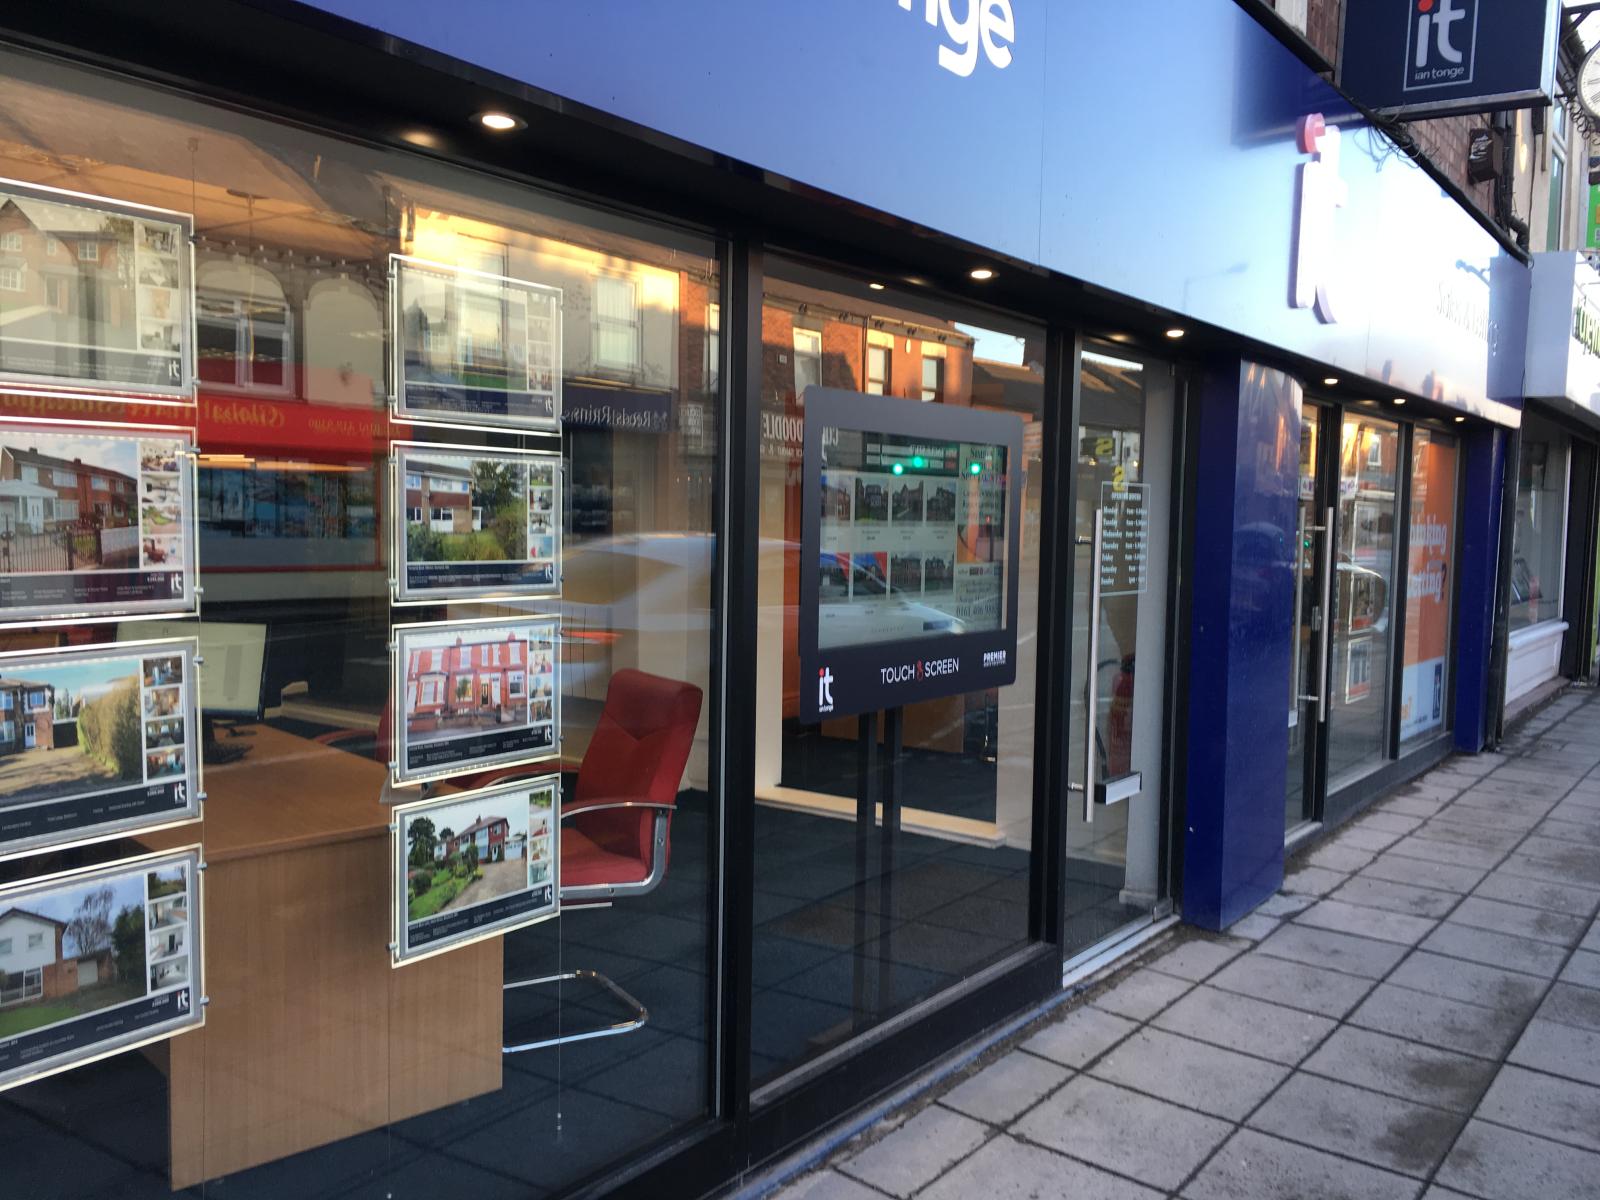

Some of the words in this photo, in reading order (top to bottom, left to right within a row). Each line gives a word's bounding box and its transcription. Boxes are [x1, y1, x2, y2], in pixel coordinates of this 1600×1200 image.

[1415, 0, 1466, 67] it
[1415, 70, 1430, 80] ian
[1432, 66, 1464, 79] tonge
[983, 649, 1006, 663] PREMIER
[880, 664, 915, 684] TOUCH
[925, 657, 959, 678] SCREEN
[818, 667, 834, 706] it
